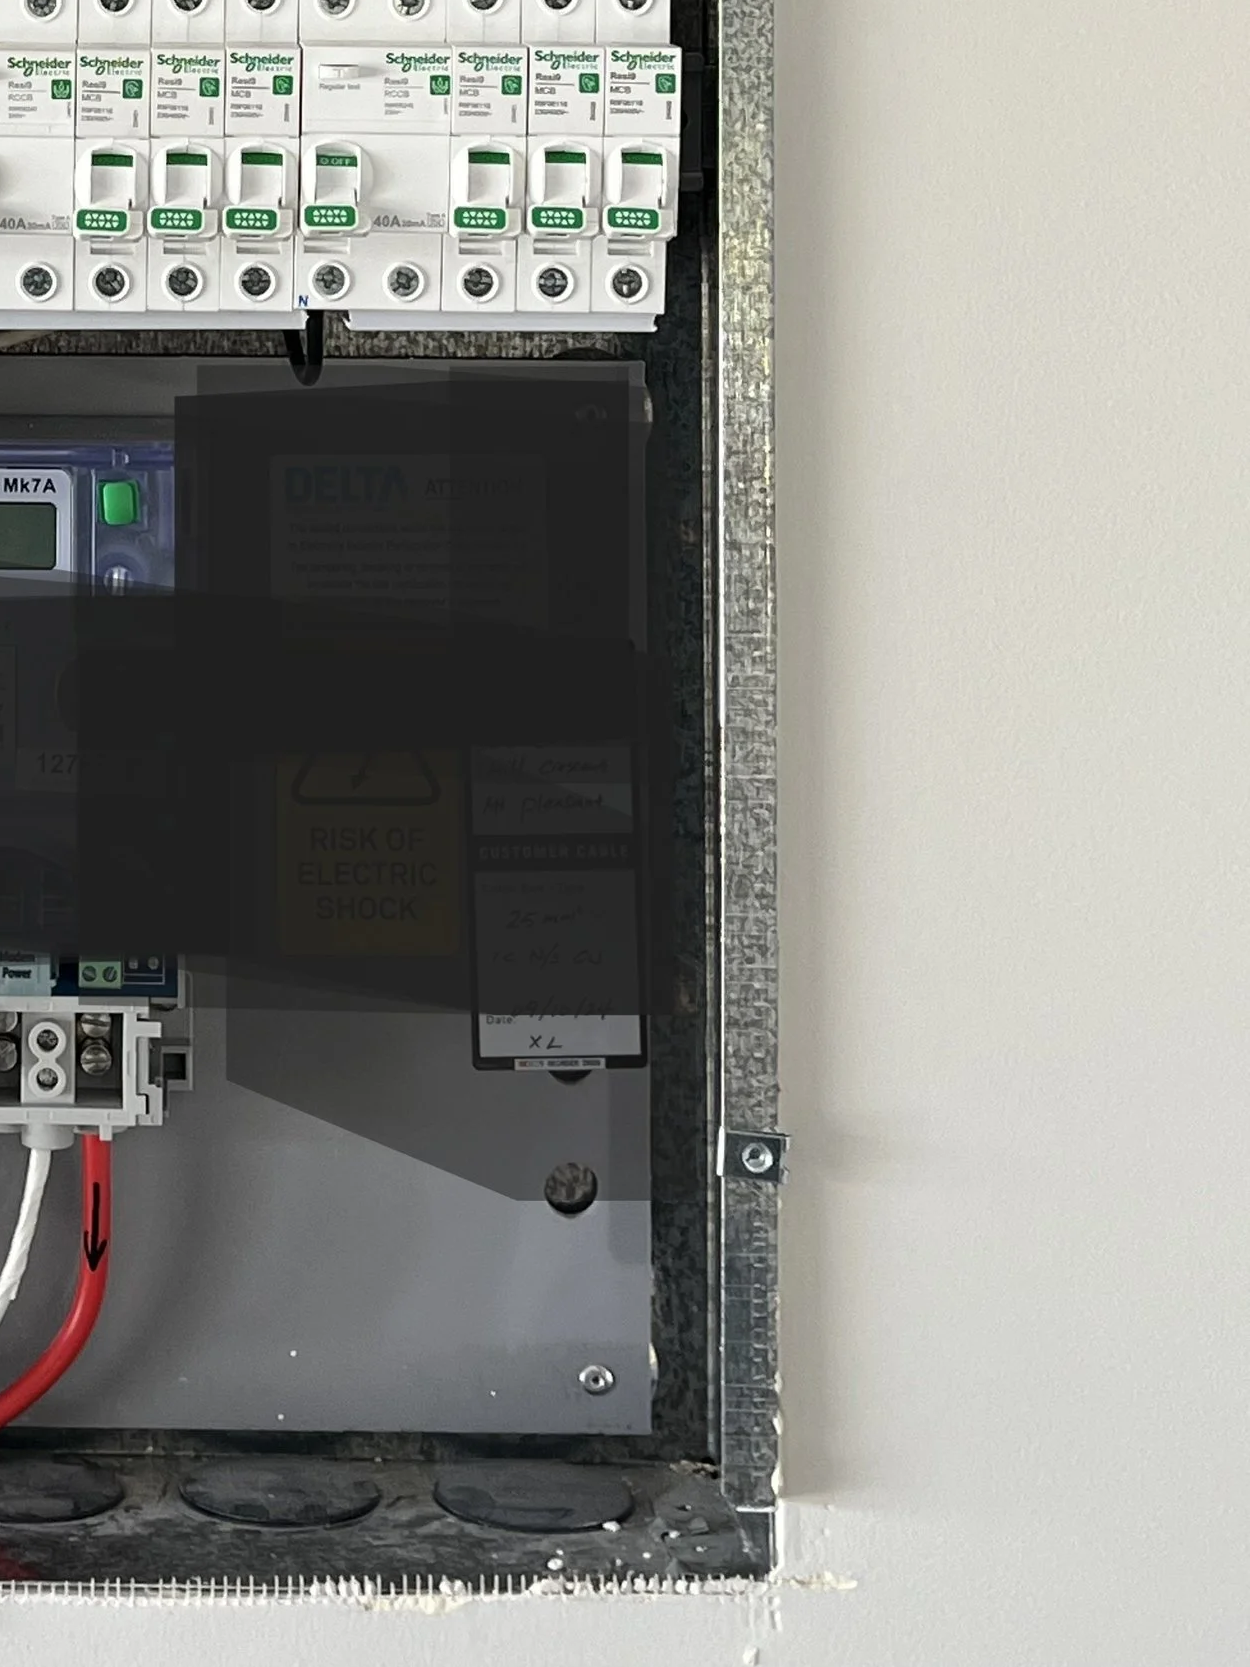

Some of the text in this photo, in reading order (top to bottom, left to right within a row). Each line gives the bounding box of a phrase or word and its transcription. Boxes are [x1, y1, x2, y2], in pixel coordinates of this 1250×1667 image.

[7, 57, 71, 77] Schneider
[80, 56, 144, 76] Schneider
[156, 54, 221, 73] Schneider
[230, 52, 294, 72] Schneider
[386, 52, 451, 72] Schneider
[458, 52, 523, 71] Schneider
[534, 50, 600, 70] Schneider
[611, 50, 676, 70] Schneider
[0, 217, 27, 230] 40A
[373, 215, 401, 228] 40A
[298, 295, 308, 307] N
[4, 477, 57, 493] Mk7A
[310, 827, 424, 853] RISK OF
[297, 862, 439, 887] ELECTRIC
[316, 896, 418, 921] SHOCK
[1, 967, 33, 980] Power
